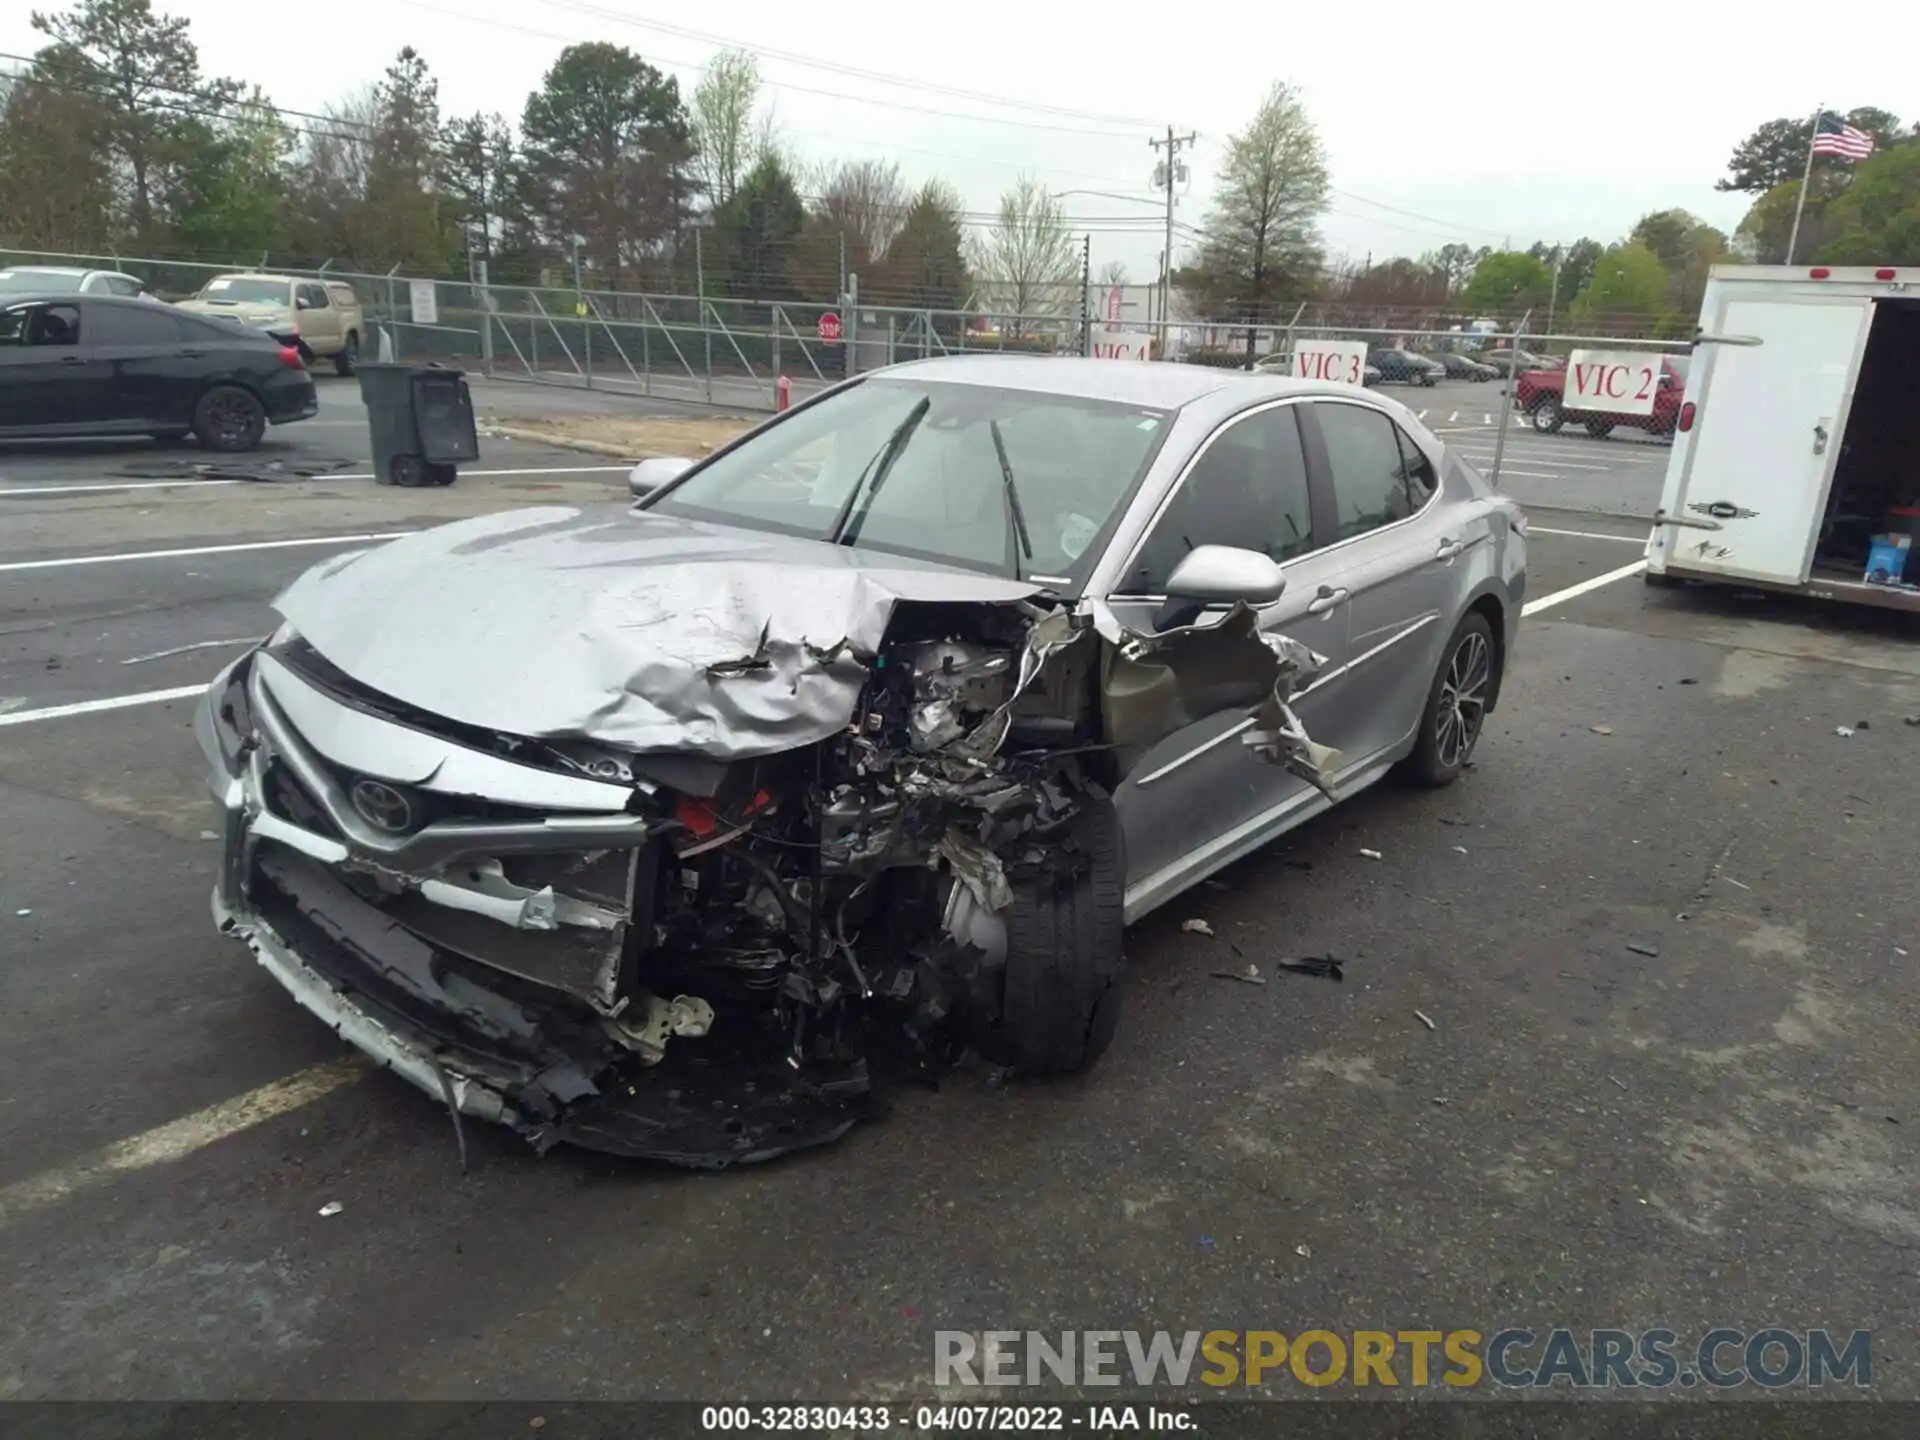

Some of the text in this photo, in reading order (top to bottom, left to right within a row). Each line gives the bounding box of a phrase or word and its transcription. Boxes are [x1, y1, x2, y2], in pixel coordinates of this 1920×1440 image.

[818, 323, 840, 337] STOP
[1094, 343, 1130, 359] VIC
[1299, 352, 1360, 384] VIC 3
[1575, 364, 1653, 400] VIC 2
